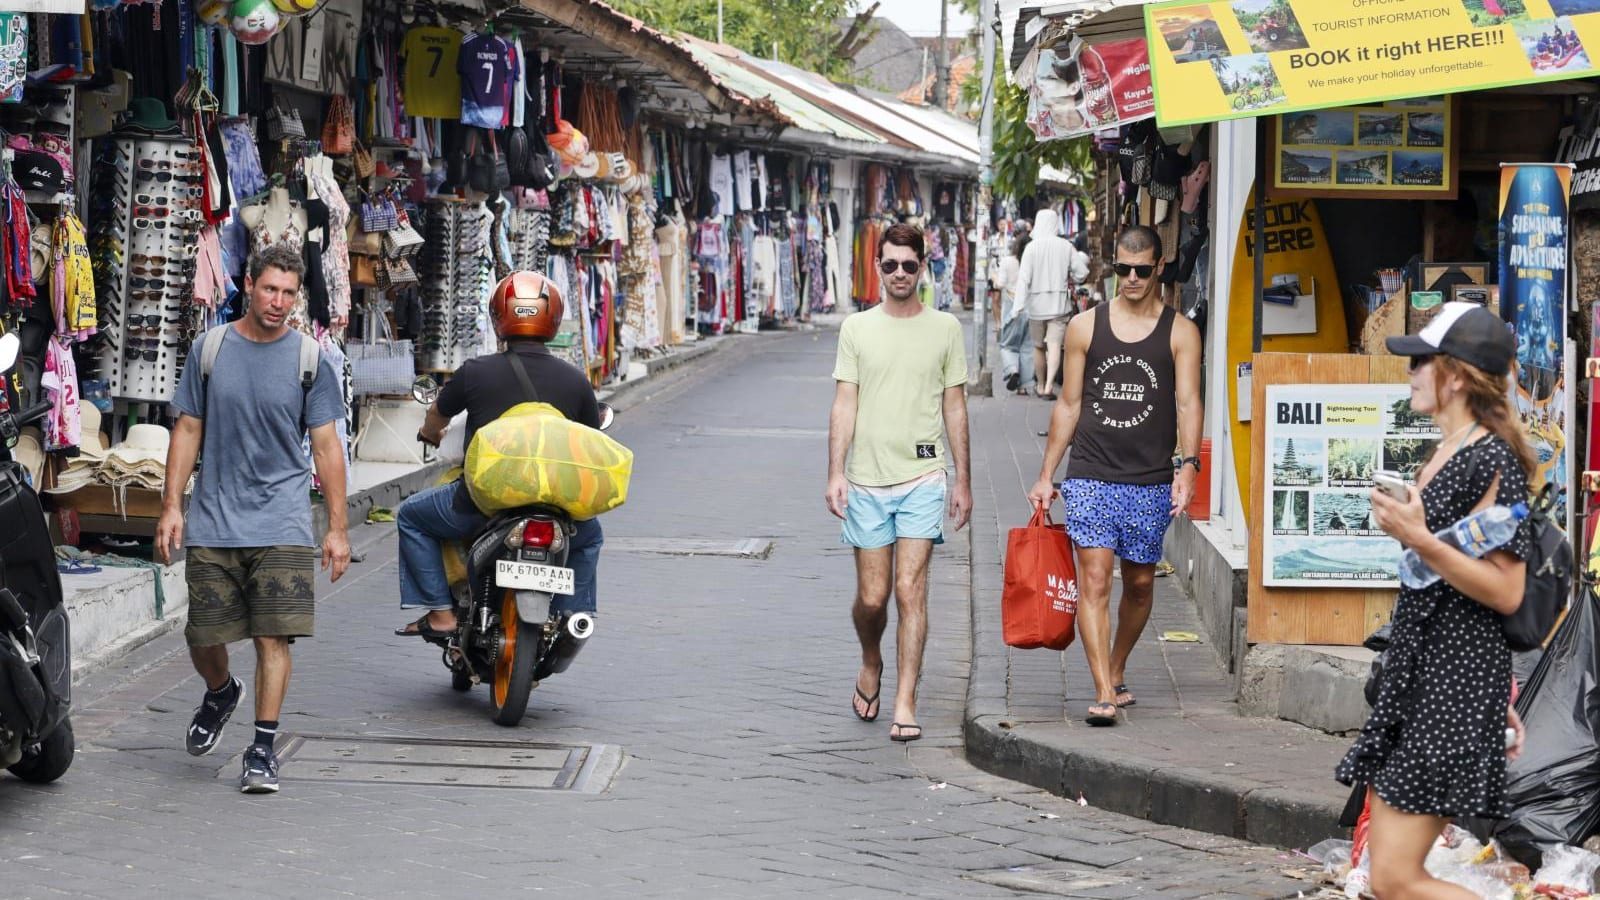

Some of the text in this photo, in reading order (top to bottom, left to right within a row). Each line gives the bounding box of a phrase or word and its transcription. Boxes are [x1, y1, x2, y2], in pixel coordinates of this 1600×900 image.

[1313, 7, 1451, 33] TOURIST INFORMATION
[1289, 29, 1505, 70] BOOK it right HERE!!!
[426, 47, 443, 79] 7
[481, 62, 494, 94] 7
[1307, 79, 1325, 89] We
[1327, 75, 1355, 88] make
[1356, 73, 1379, 85] your
[1381, 67, 1416, 80] holiday
[1511, 213, 1563, 236] SUBMARINE
[1509, 243, 1565, 271] ADVENTURE
[1136, 358, 1159, 390] corner
[1102, 390, 1144, 402] PALAWAN
[1103, 382, 1145, 393] EL NIDO
[1092, 401, 1154, 428] of paradise
[1277, 402, 1322, 424] BALI
[473, 531, 498, 562] HONDA
[499, 562, 572, 581] DK 6705 AAV
